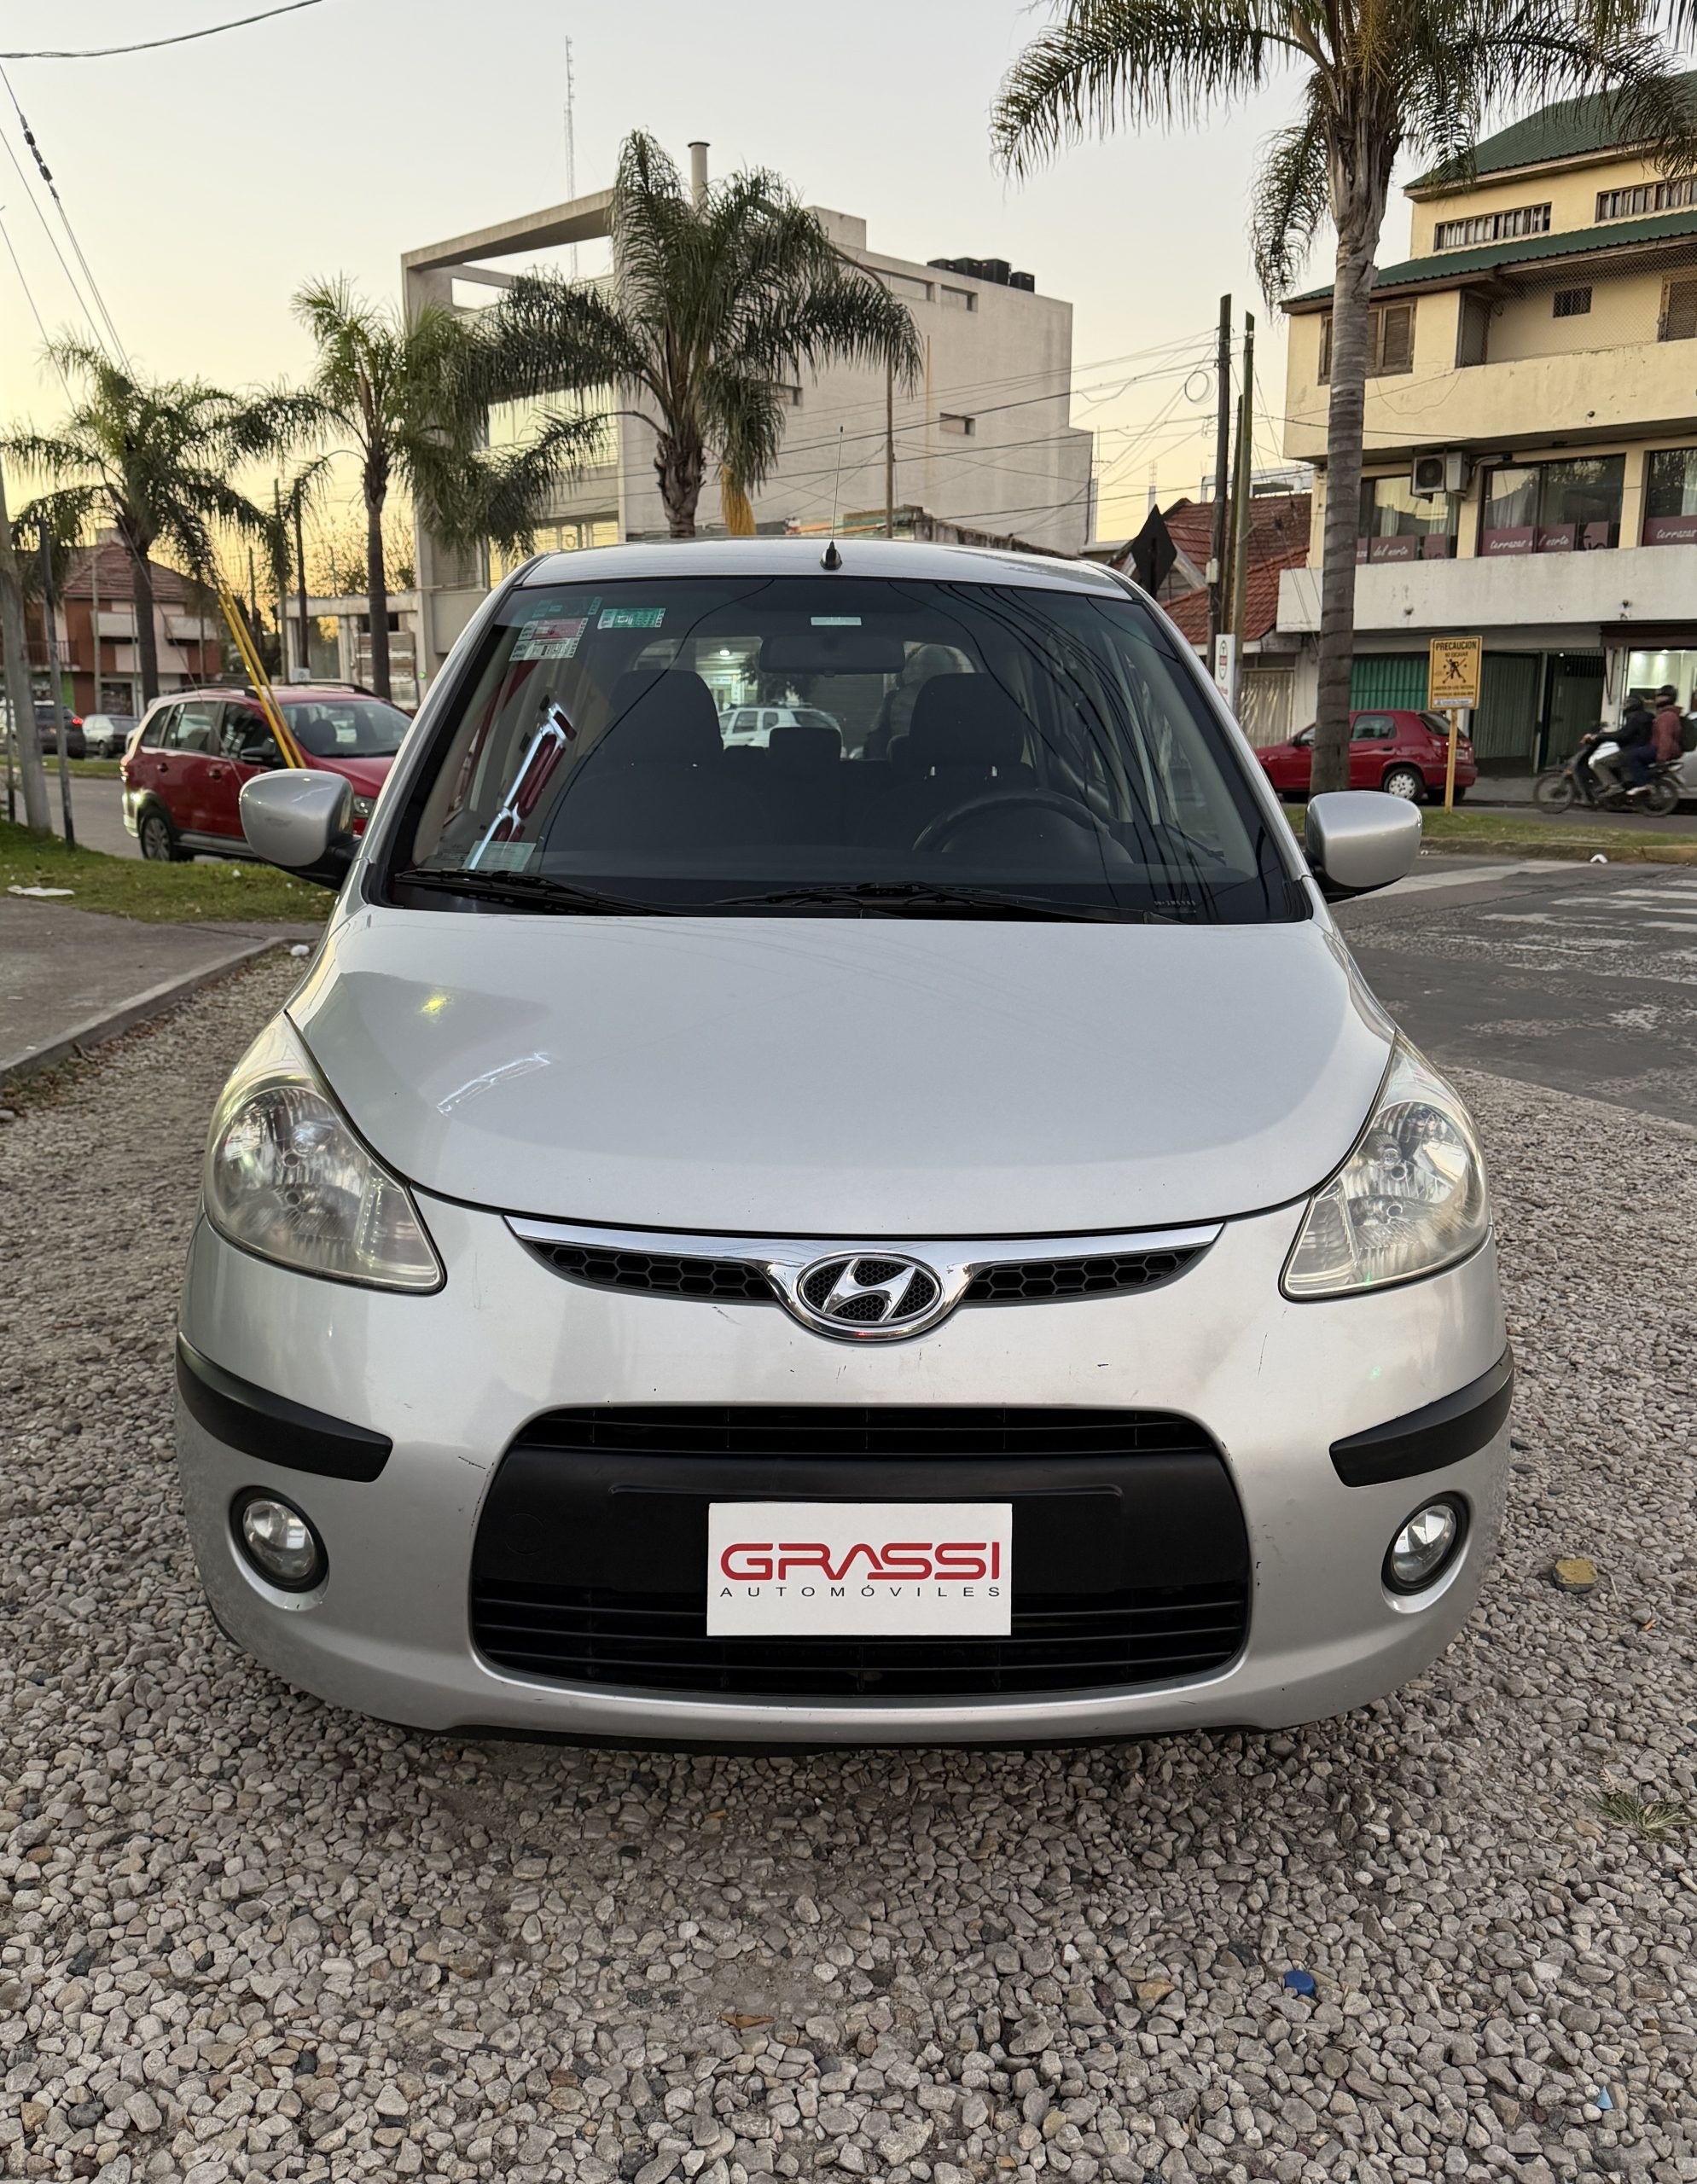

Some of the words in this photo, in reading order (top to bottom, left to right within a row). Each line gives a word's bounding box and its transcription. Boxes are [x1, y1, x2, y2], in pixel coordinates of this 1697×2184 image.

[1490, 539, 1526, 549] terrazas
[1436, 641, 1477, 651] PRECAUCION
[720, 1542, 1000, 1581] GRASSI
[720, 1584, 1000, 1598] AUTOMÓVILES
